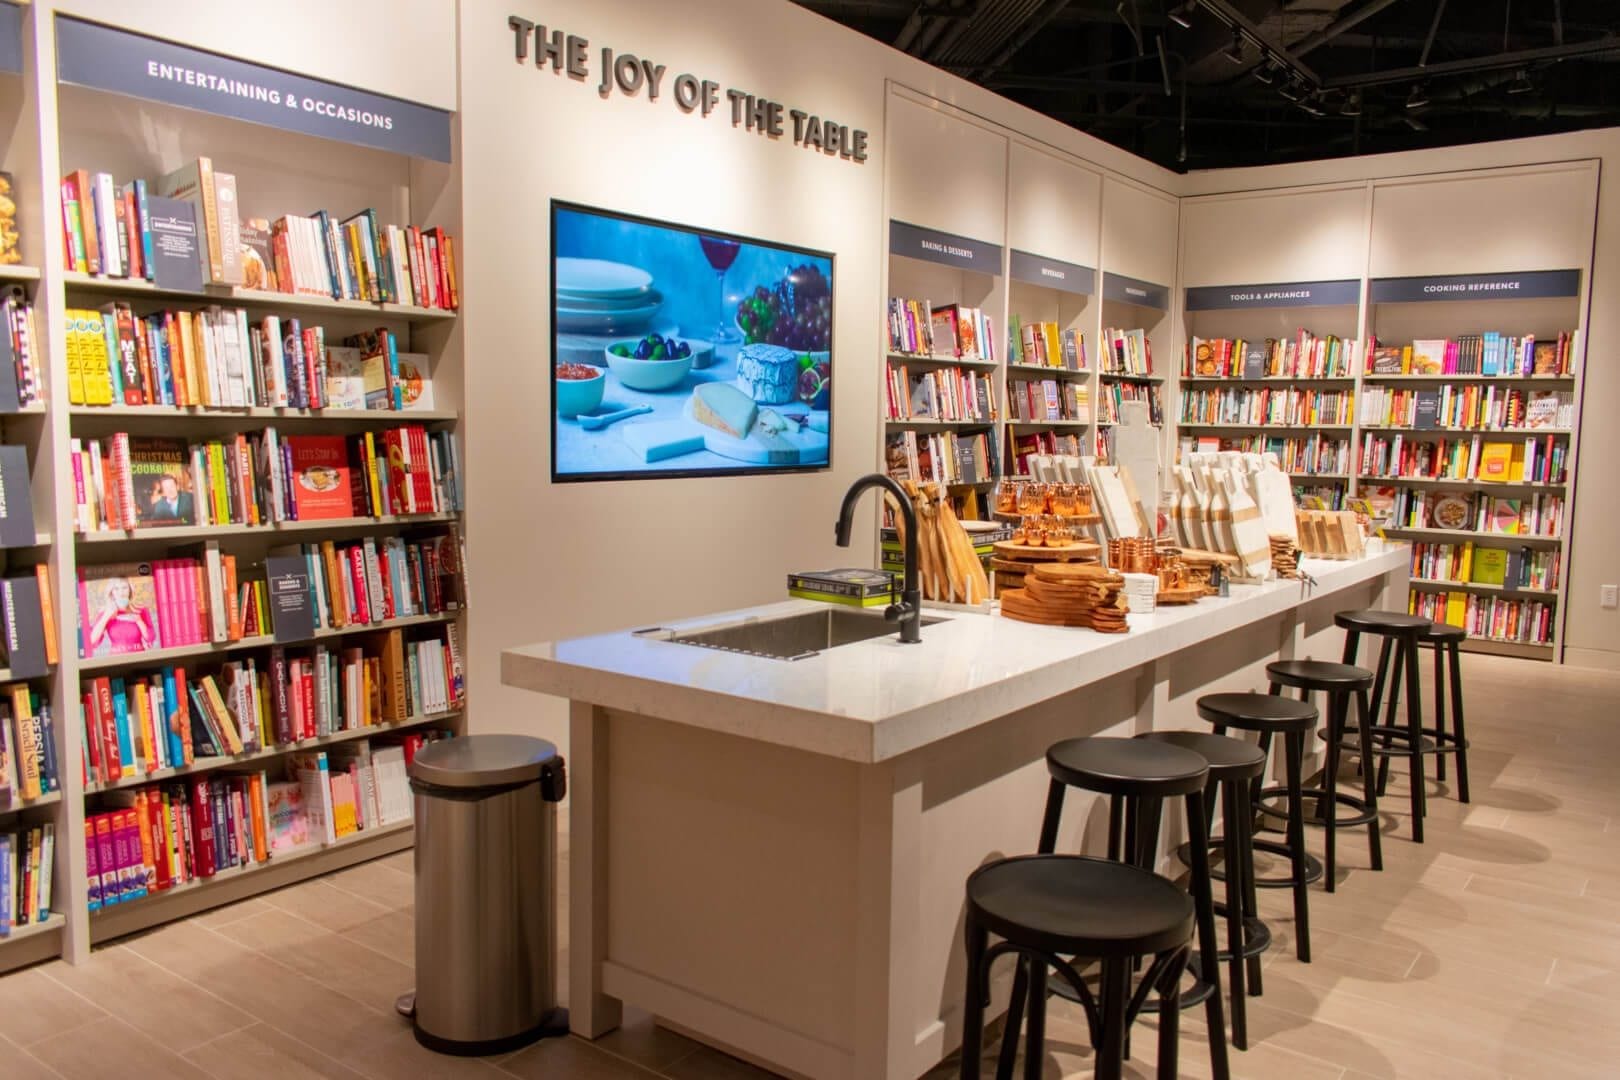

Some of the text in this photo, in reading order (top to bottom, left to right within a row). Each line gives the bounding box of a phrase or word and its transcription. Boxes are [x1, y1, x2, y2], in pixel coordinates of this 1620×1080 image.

[147, 60, 394, 131] ENTERTAINING & OCCASIONS
[508, 15, 868, 161] THE JOY OF THE TABLE
[921, 239, 973, 259] BAKING & DESSERTS
[1041, 267, 1065, 280] BEVERAGES
[1423, 282, 1521, 293] COOKING REFERENCE
[1230, 290, 1311, 301] TOOLS & APPLIANCES
[121, 338, 136, 385] MEAT
[131, 462, 182, 475] COOKBOOK
[353, 549, 363, 579] CAKES
[7, 581, 19, 652] MEDITERRANEAN
[21, 717, 38, 780] Israeli Soul
